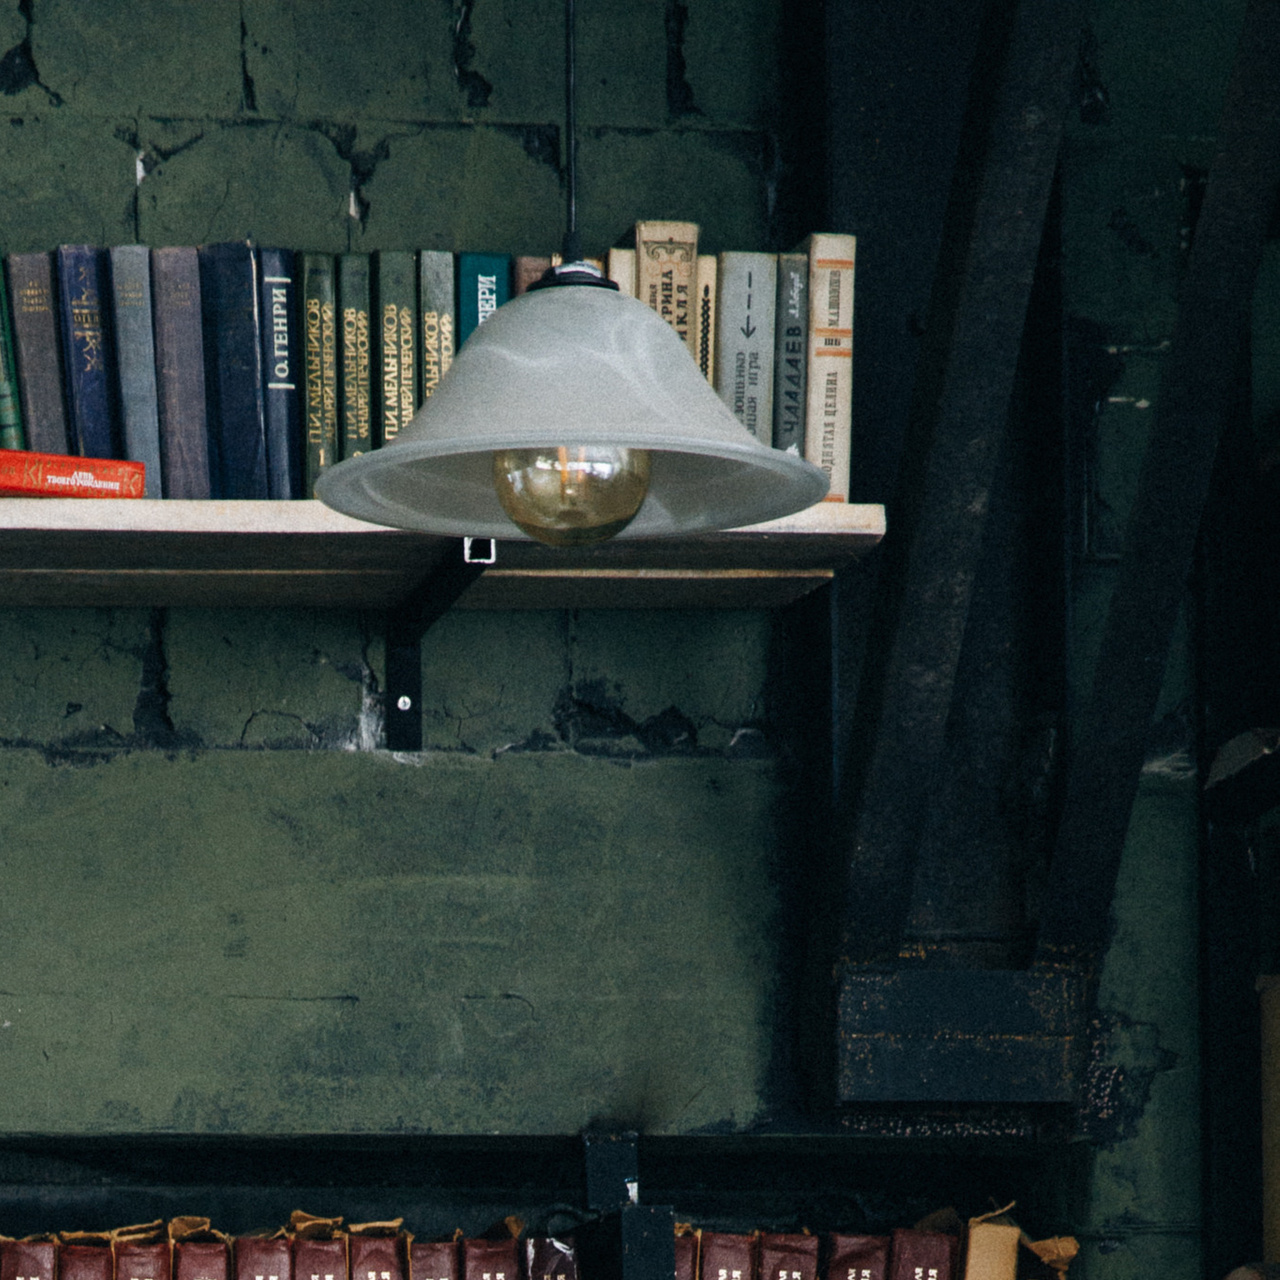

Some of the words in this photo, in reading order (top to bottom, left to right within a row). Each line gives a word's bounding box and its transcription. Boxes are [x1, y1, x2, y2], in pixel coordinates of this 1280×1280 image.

[272, 288, 288, 357] ГЕНРИ
[307, 299, 321, 406] МЕЛЬНИКОВ
[344, 308, 356, 405] МЕЛЬНИКОВ
[384, 304, 398, 405] МЕЛЬНИКОВ
[784, 325, 802, 433] ЧААДАЕВ
[824, 371, 838, 417] ЦЕЛИНА
